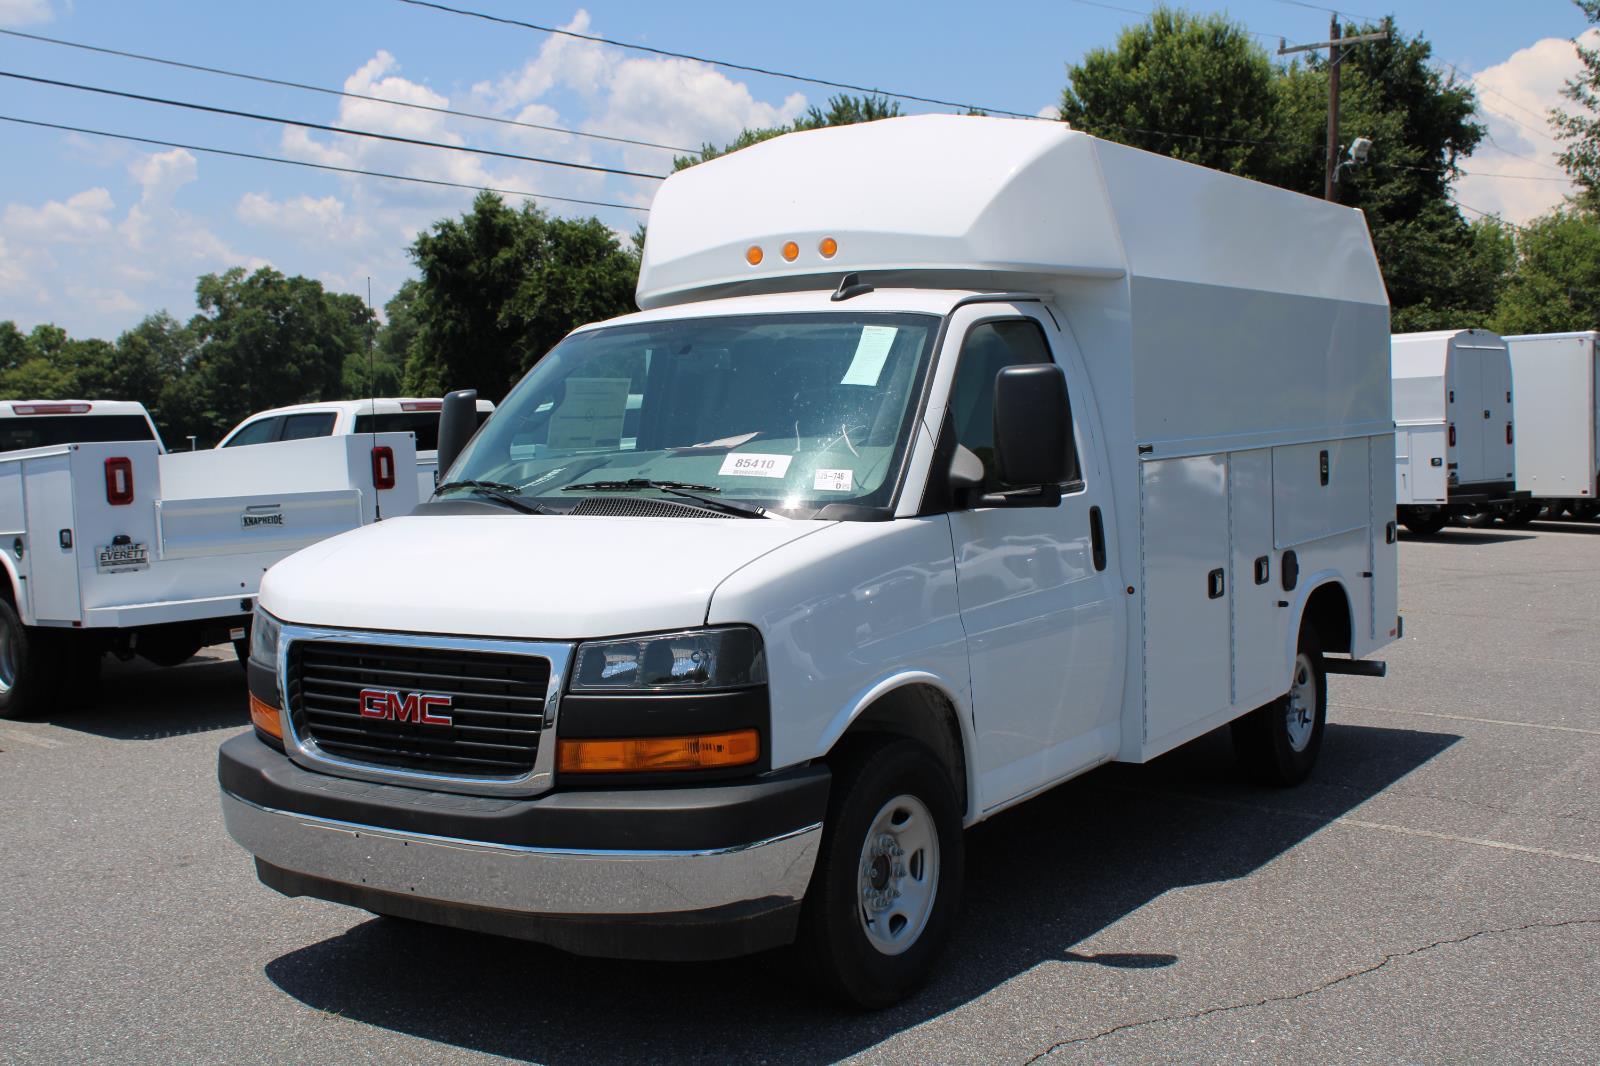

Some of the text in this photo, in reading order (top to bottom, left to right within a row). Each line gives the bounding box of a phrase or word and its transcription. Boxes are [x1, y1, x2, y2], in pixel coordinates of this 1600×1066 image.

[735, 458, 775, 469] 85410
[243, 513, 283, 528] KNAPHEIDE
[100, 550, 147, 561] EVERETT
[360, 688, 452, 726] GMC
